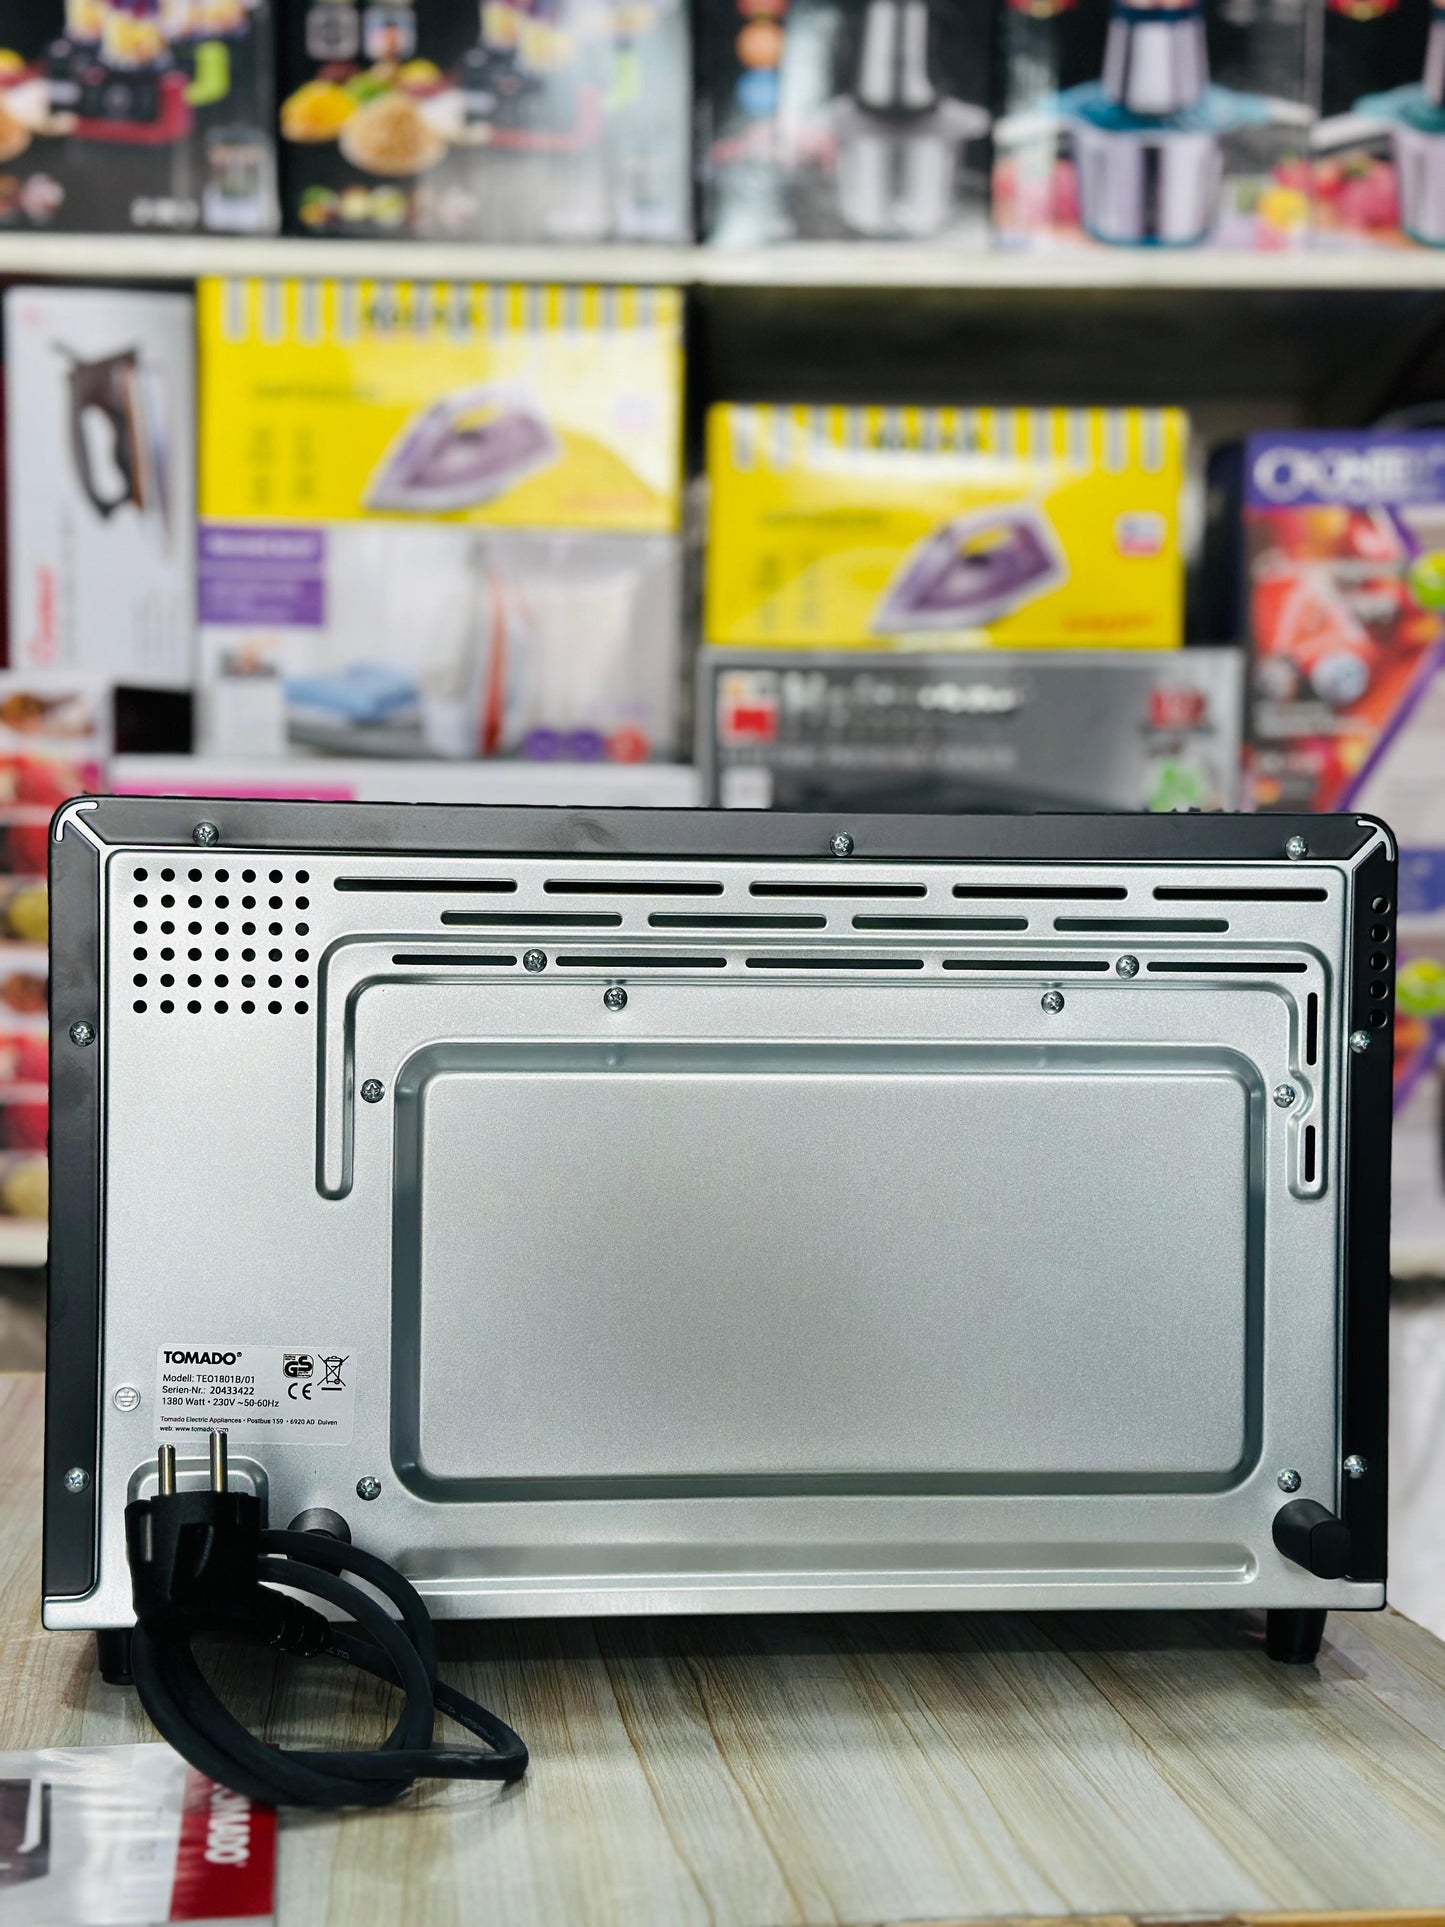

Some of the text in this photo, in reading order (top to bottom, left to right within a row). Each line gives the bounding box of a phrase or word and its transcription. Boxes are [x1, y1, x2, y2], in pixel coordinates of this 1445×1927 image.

[162, 1374, 194, 1383] Modell:
[161, 1385, 255, 1395] Serien-Nr.: 20433422
[161, 1397, 184, 1406] 1380
[185, 1397, 206, 1406] Watt
[212, 1398, 236, 1406] 230V
[160, 1415, 185, 1423] Tomado
[209, 1416, 242, 1424] Appliances
[204, 1781, 250, 1865] OMADO
